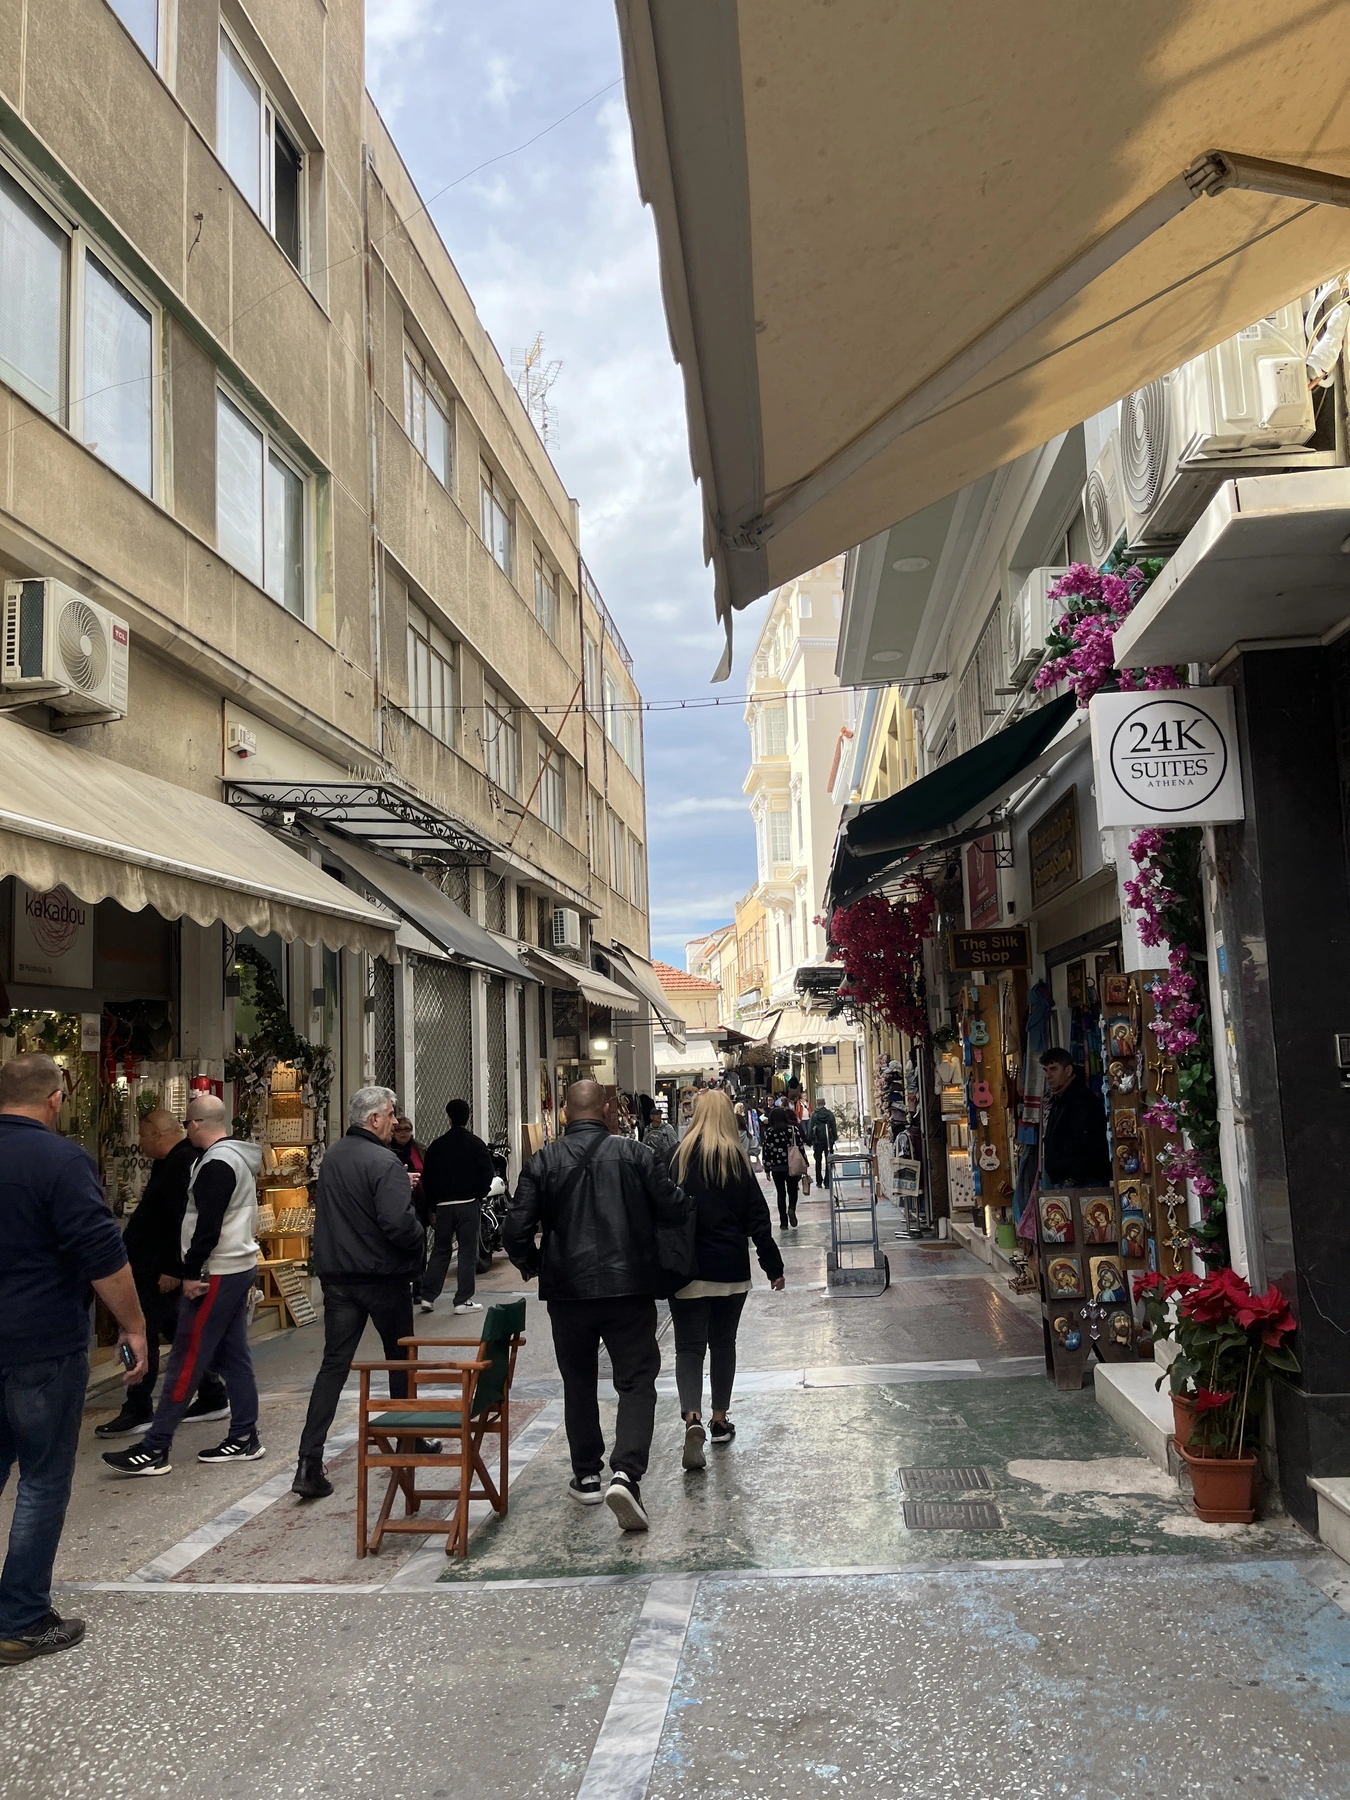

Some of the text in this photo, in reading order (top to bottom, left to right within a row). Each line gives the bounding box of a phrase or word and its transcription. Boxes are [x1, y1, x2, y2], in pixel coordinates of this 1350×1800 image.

[115, 629, 126, 641] TCL
[1129, 718, 1206, 753] 24K
[1131, 758, 1208, 779] SUITES
[1147, 779, 1194, 788] ATHENA
[25, 891, 86, 926] kakadou
[984, 893, 997, 910] STORE
[1121, 904, 1132, 925] 26
[959, 935, 1019, 951] The Silk
[971, 950, 1010, 964] Shop
